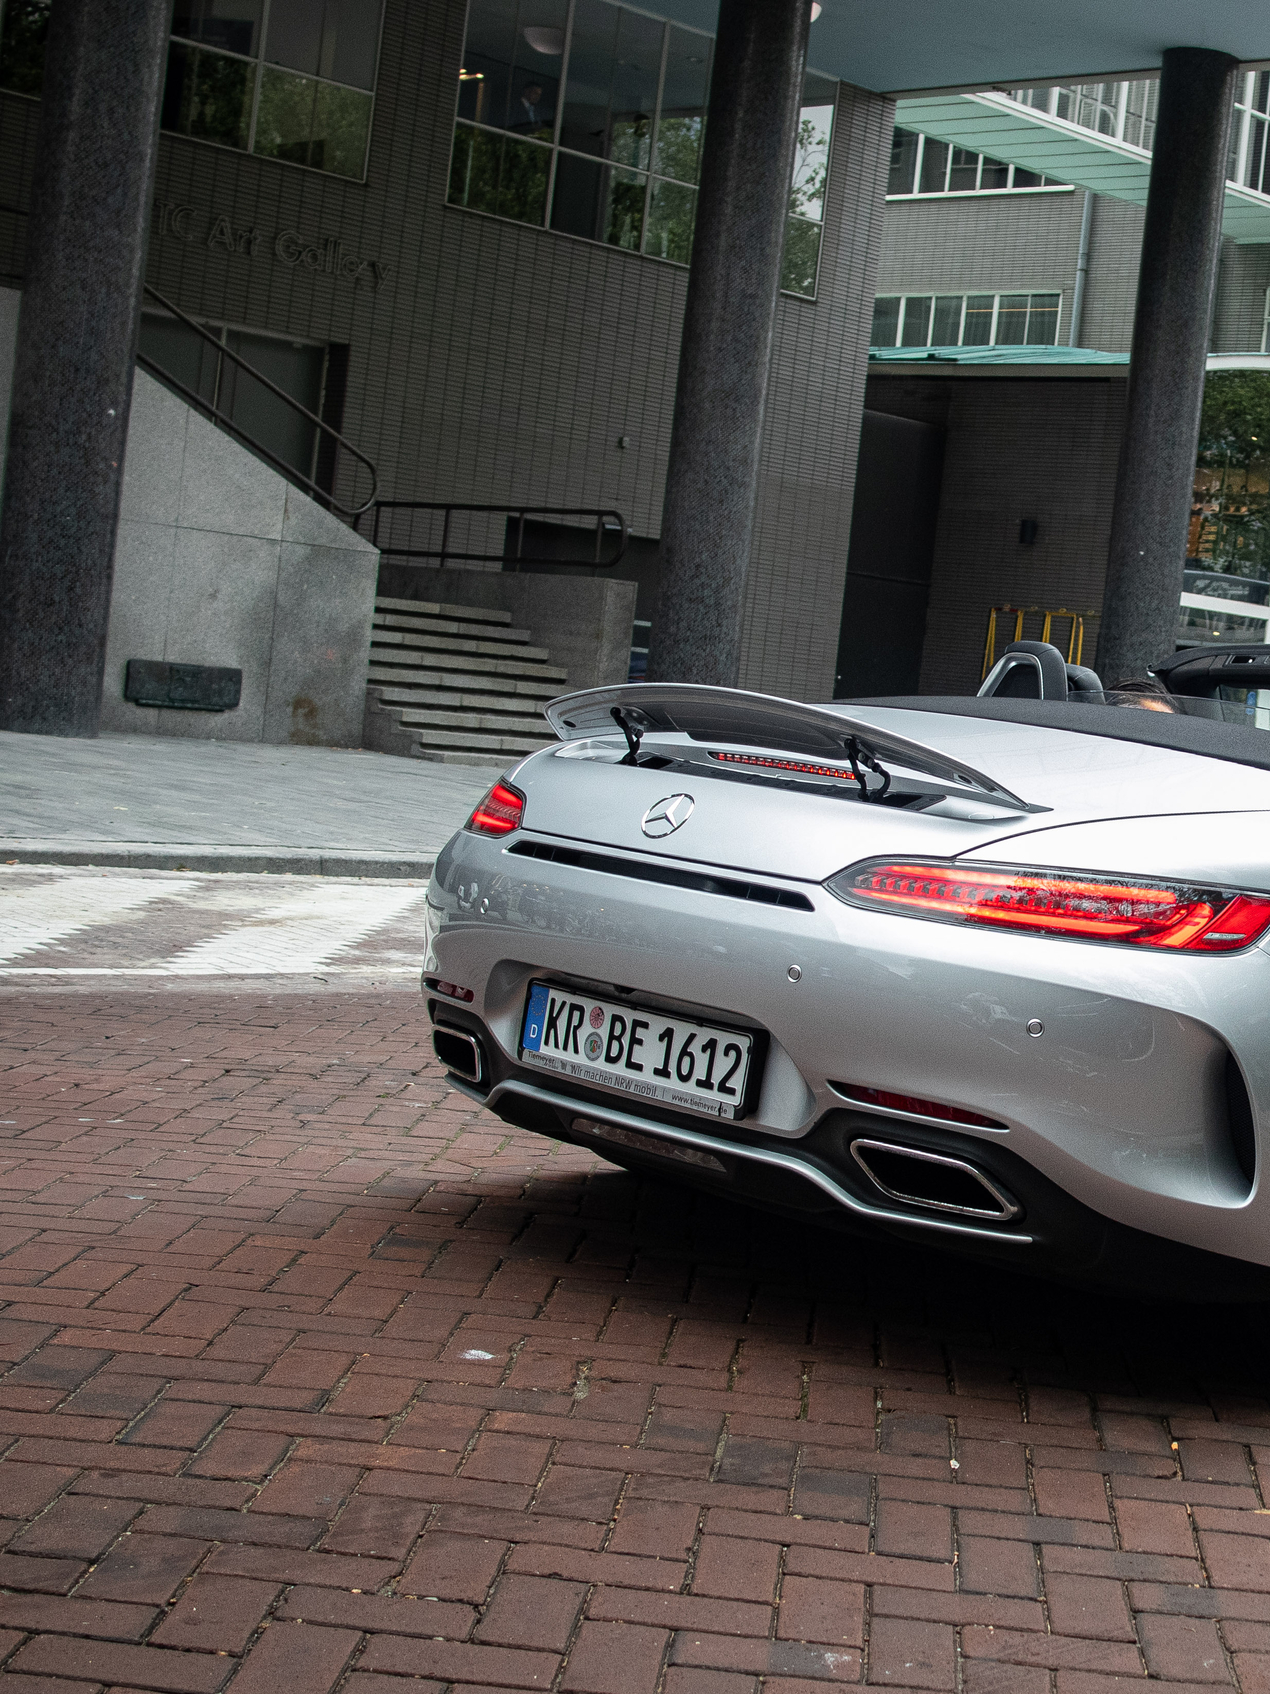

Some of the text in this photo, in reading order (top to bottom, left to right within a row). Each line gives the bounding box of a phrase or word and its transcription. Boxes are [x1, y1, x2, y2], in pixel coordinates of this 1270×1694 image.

[207, 214, 261, 255] Art
[275, 230, 394, 291] Gallery
[529, 1023, 539, 1039] D
[543, 997, 743, 1097] KR BE 1612
[584, 1068, 614, 1085] machen
[614, 1076, 633, 1091] NRW
